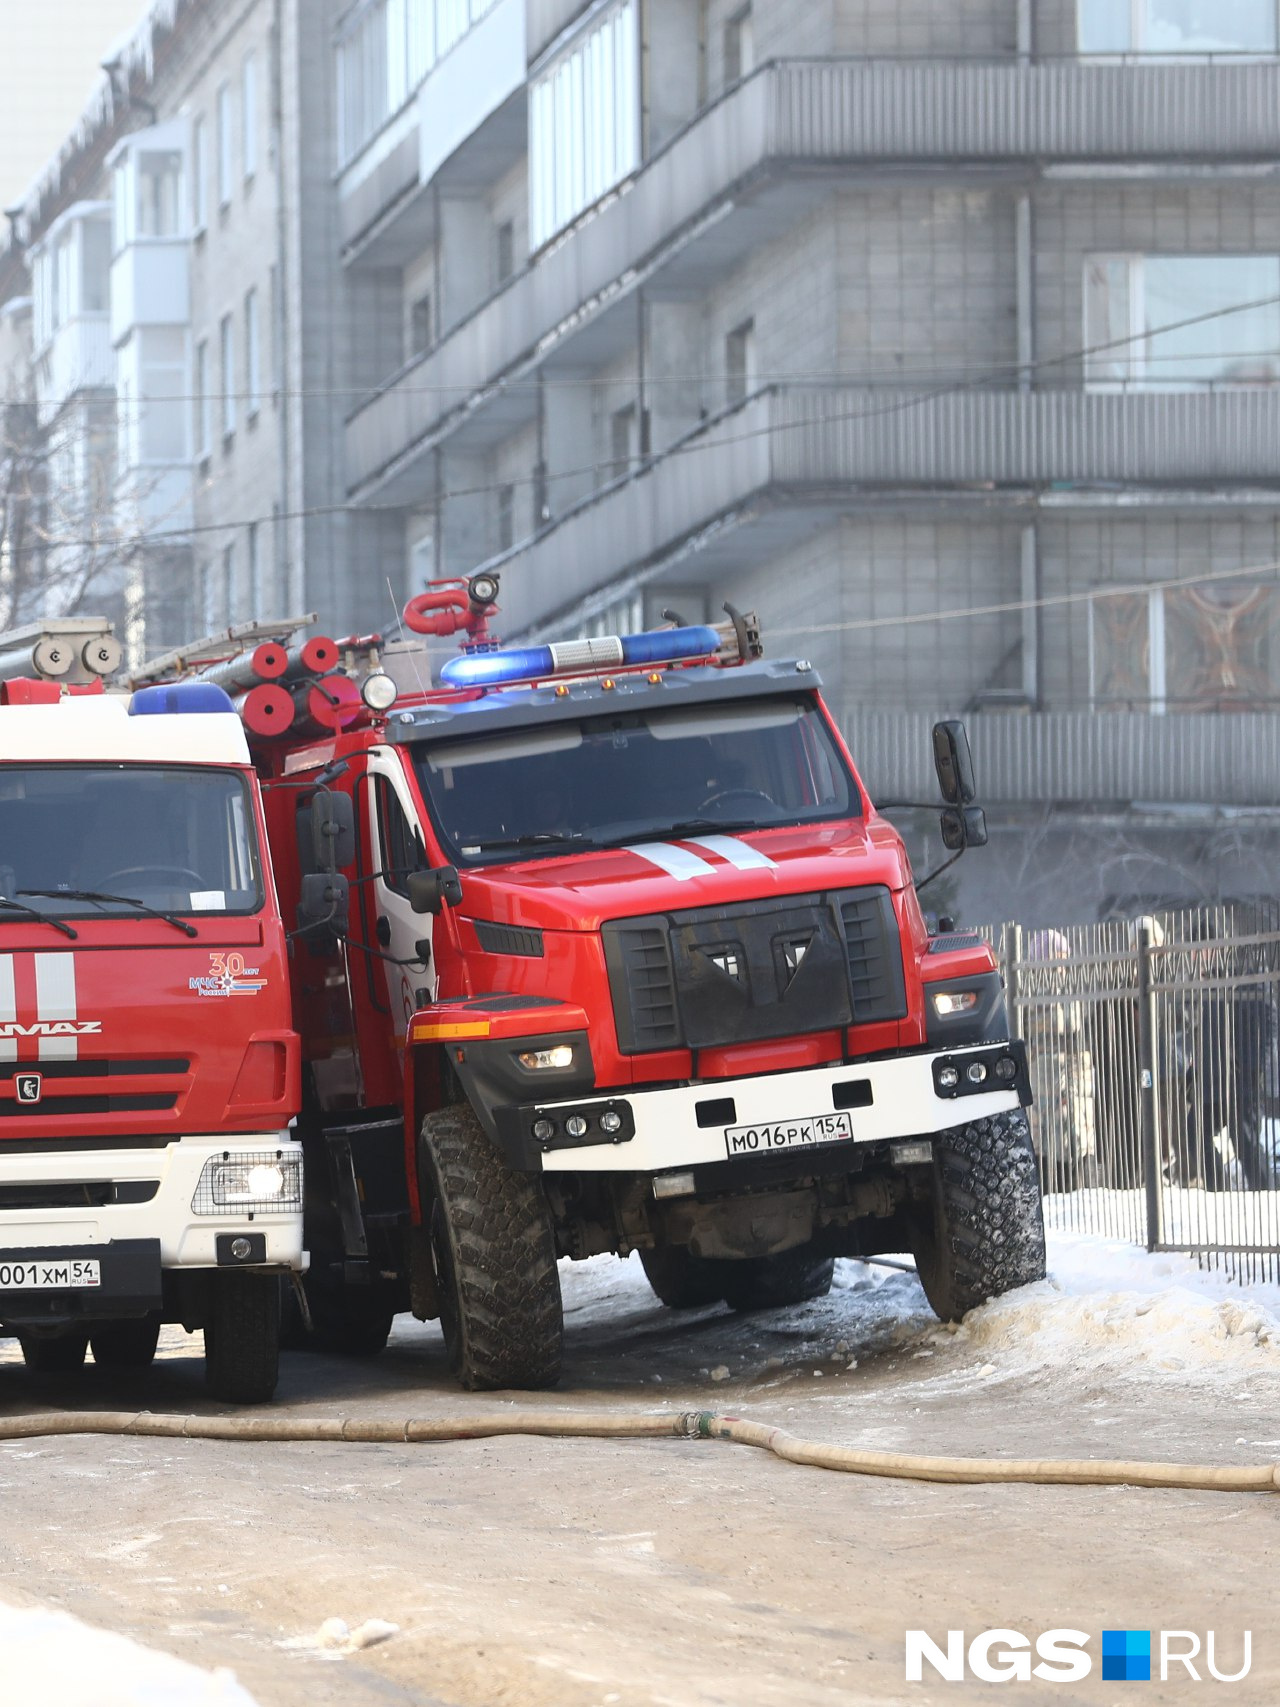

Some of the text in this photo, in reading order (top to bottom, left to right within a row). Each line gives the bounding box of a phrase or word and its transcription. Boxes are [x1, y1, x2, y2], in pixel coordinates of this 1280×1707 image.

[209, 952, 245, 977] 30
[189, 977, 219, 990] МЧС
[815, 1116, 847, 1135] 154
[73, 1262, 93, 1278] 54
